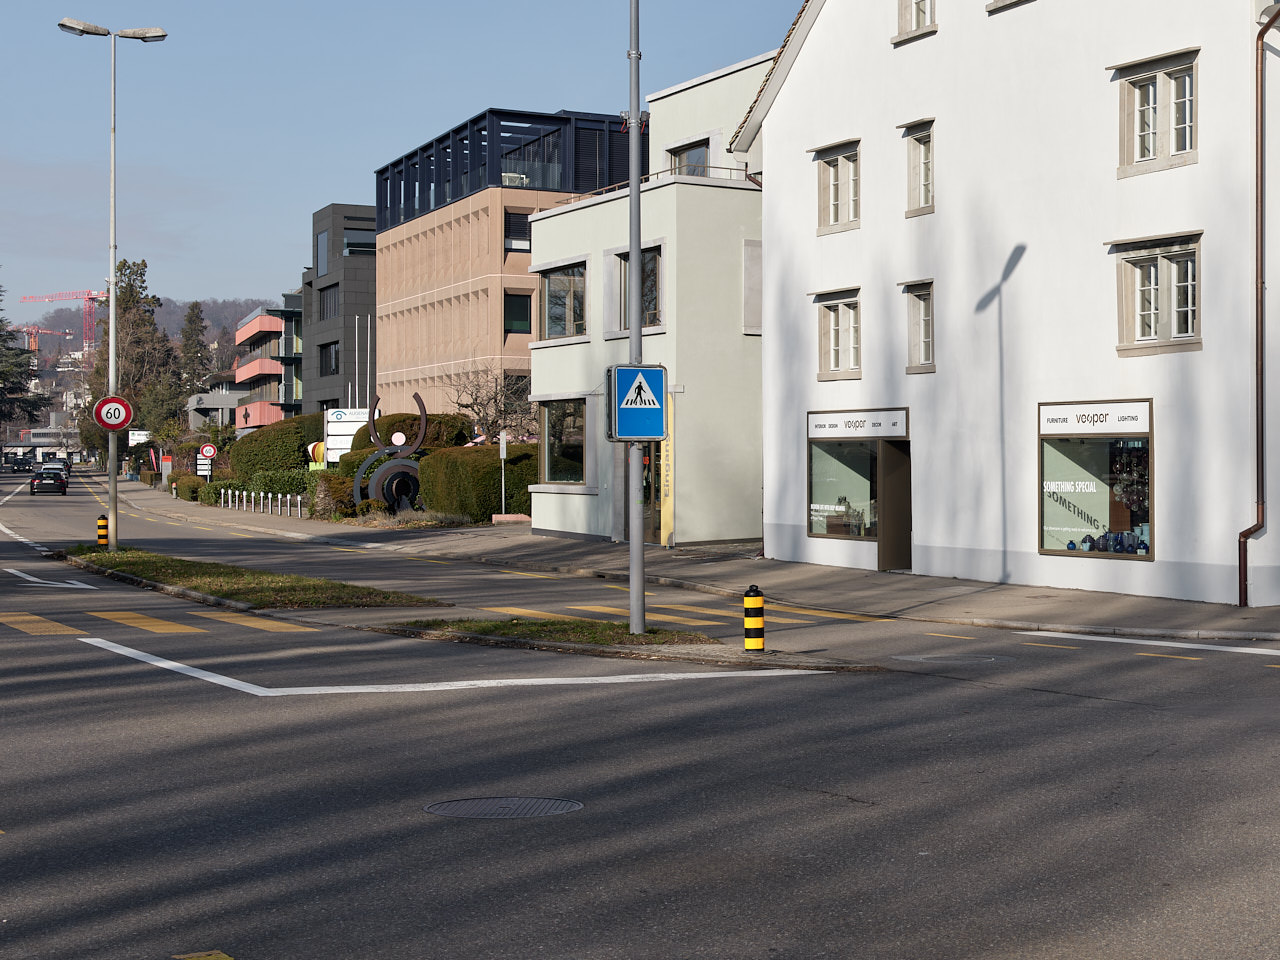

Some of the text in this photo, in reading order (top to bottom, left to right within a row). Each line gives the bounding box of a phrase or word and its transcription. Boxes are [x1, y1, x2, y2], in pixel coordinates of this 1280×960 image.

[105, 407, 121, 420] 60
[1075, 412, 1110, 427] vesper
[204, 447, 213, 455] 60
[1043, 481, 1097, 493] SOMETHING SPECIAL
